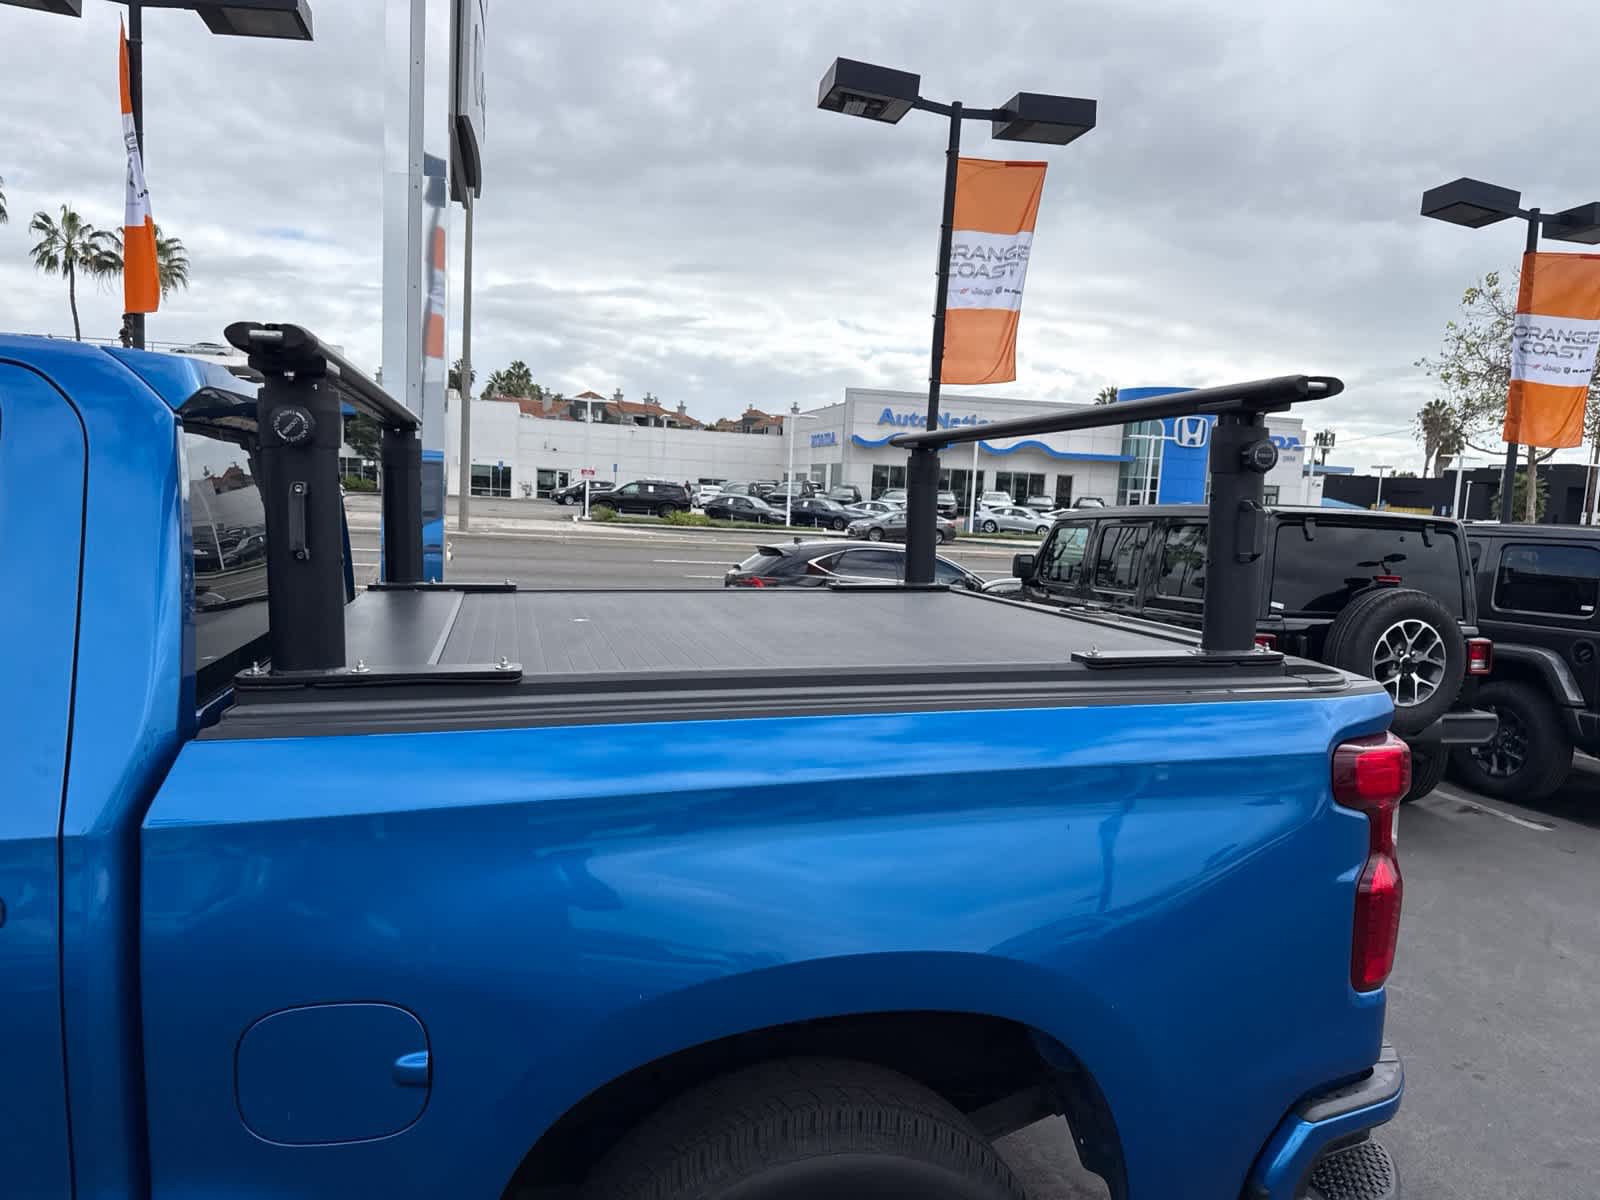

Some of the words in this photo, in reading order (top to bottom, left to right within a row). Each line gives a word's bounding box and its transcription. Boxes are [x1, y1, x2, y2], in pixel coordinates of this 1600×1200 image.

[949, 244, 1029, 262] RANGE
[1513, 326, 1600, 345] ORANGE
[1519, 341, 1589, 359] COAST
